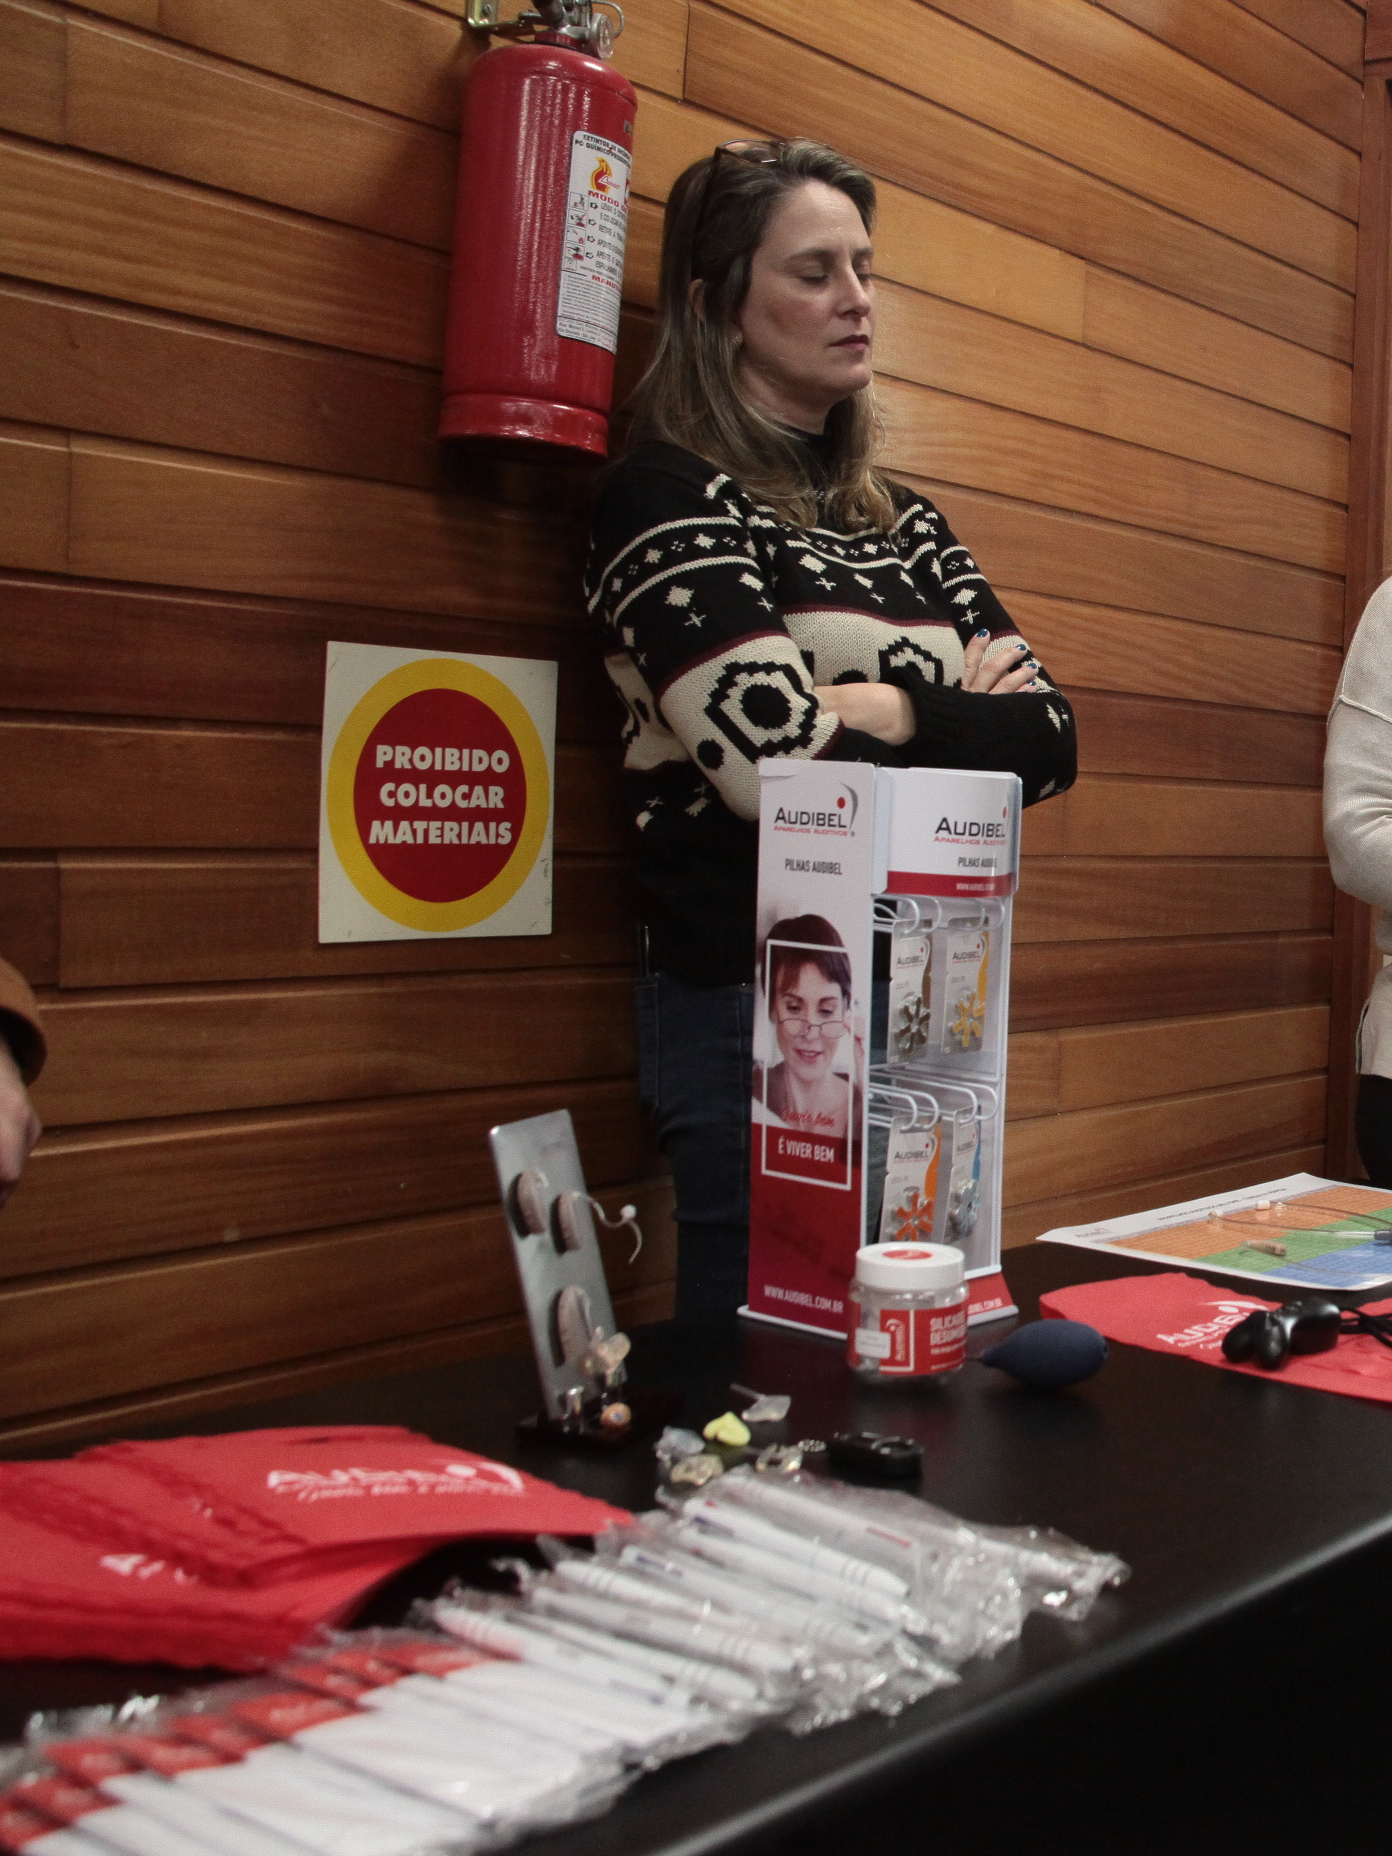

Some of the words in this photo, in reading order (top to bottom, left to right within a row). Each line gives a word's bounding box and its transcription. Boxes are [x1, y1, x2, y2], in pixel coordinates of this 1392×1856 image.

[588, 190, 620, 208] MODO
[375, 745, 511, 774] PROIBIDO
[379, 782, 505, 809] COLOCAR
[774, 806, 847, 829] AUDIBEL
[934, 817, 1006, 838] AUDIBEL
[368, 820, 513, 845] MATERIAIS
[784, 858, 811, 872] PILHAS
[812, 860, 843, 876] AUDIBEL
[957, 857, 980, 868] PILHAS
[778, 1135, 785, 1155] É
[786, 1139, 813, 1160] VIVER
[814, 1144, 835, 1164] BEM
